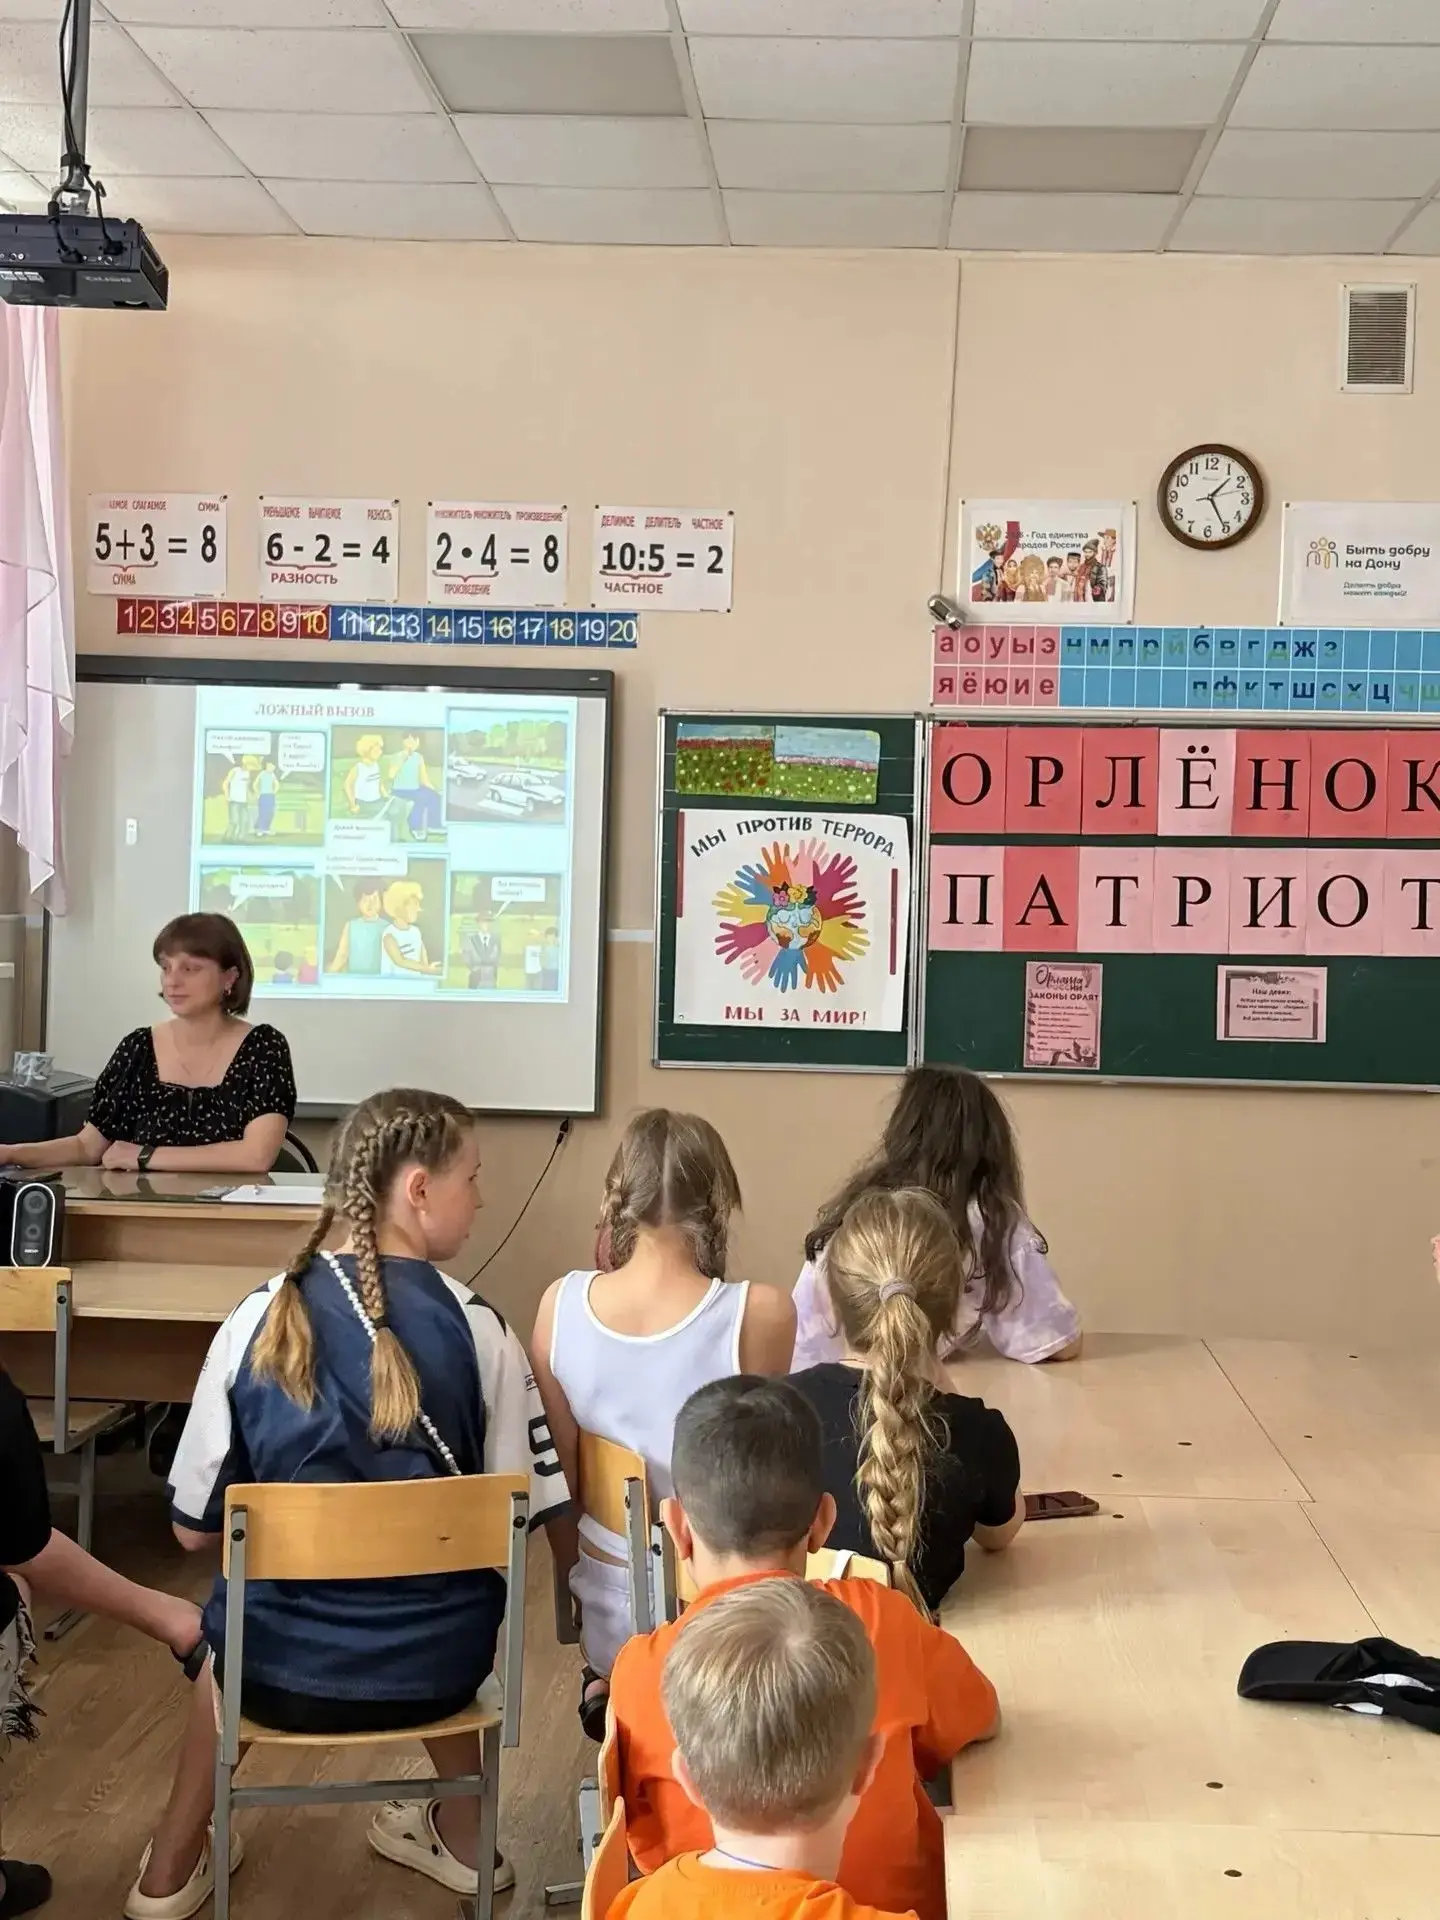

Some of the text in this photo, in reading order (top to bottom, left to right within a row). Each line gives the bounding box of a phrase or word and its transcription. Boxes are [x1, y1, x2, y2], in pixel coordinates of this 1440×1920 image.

[1190, 462, 1198, 475] 11
[1206, 457, 1220, 470] 12
[1226, 463, 1231, 476] 1
[1176, 474, 1189, 488] 10
[1236, 476, 1246, 489] 2
[1169, 490, 1178, 503] 9
[1240, 492, 1250, 506] 3
[197, 502, 220, 512] СУММА
[1174, 508, 1184, 521] 8
[1234, 510, 1242, 523] 4
[600, 514, 724, 530] ДЕЛИМОЕ ДЕЛИТЕЛЬ ЧАСТНОЕ
[1188, 520, 1196, 533] 7
[1222, 522, 1231, 534] 5
[1031, 530, 1047, 540] Год
[1048, 532, 1089, 540] единства
[1204, 525, 1212, 538] 6
[1346, 544, 1430, 558] Быть добру
[1345, 558, 1401, 570] на Дону
[112, 572, 136, 586] СУММА
[270, 572, 338, 584] РАЗНОСТЬ
[604, 582, 664, 594] ЧАСТНОЕ
[124, 606, 637, 642] 1 2 3 4 5 6 7 8 9 10 11 12 13 14 15 16 17 18 19 20
[939, 636, 954, 653] а
[964, 636, 981, 654] о
[989, 636, 1006, 659] у
[1012, 637, 1034, 654] ы
[1040, 637, 1056, 654] э
[1142, 639, 1160, 661] р
[1193, 634, 1210, 655] б
[1220, 640, 1236, 656] в
[1268, 640, 1288, 660] д
[1294, 641, 1316, 658] ж
[1324, 641, 1338, 658] з
[938, 677, 954, 694] я
[962, 672, 978, 694] ё
[984, 677, 1008, 695] ю
[1014, 678, 1030, 695] и
[1039, 678, 1055, 695] е
[1214, 676, 1238, 703] ф
[1245, 681, 1259, 698] к
[1269, 682, 1284, 698] т
[1292, 682, 1315, 699] ш
[1322, 682, 1336, 698] с
[1347, 682, 1362, 700] х
[1373, 684, 1390, 704] ц
[255, 703, 375, 718] ЛОЖНЫЙ ВЫЗОВ
[941, 744, 1440, 812] ОРЛЁНОК
[690, 828, 728, 858] МЫ
[736, 816, 812, 836] ПРОТИВ
[942, 873, 1440, 930] ПАТРИОТ
[1070, 993, 1099, 1001] ОРЛЯТ
[724, 1006, 866, 1024] МЫ ЗА МИР!
